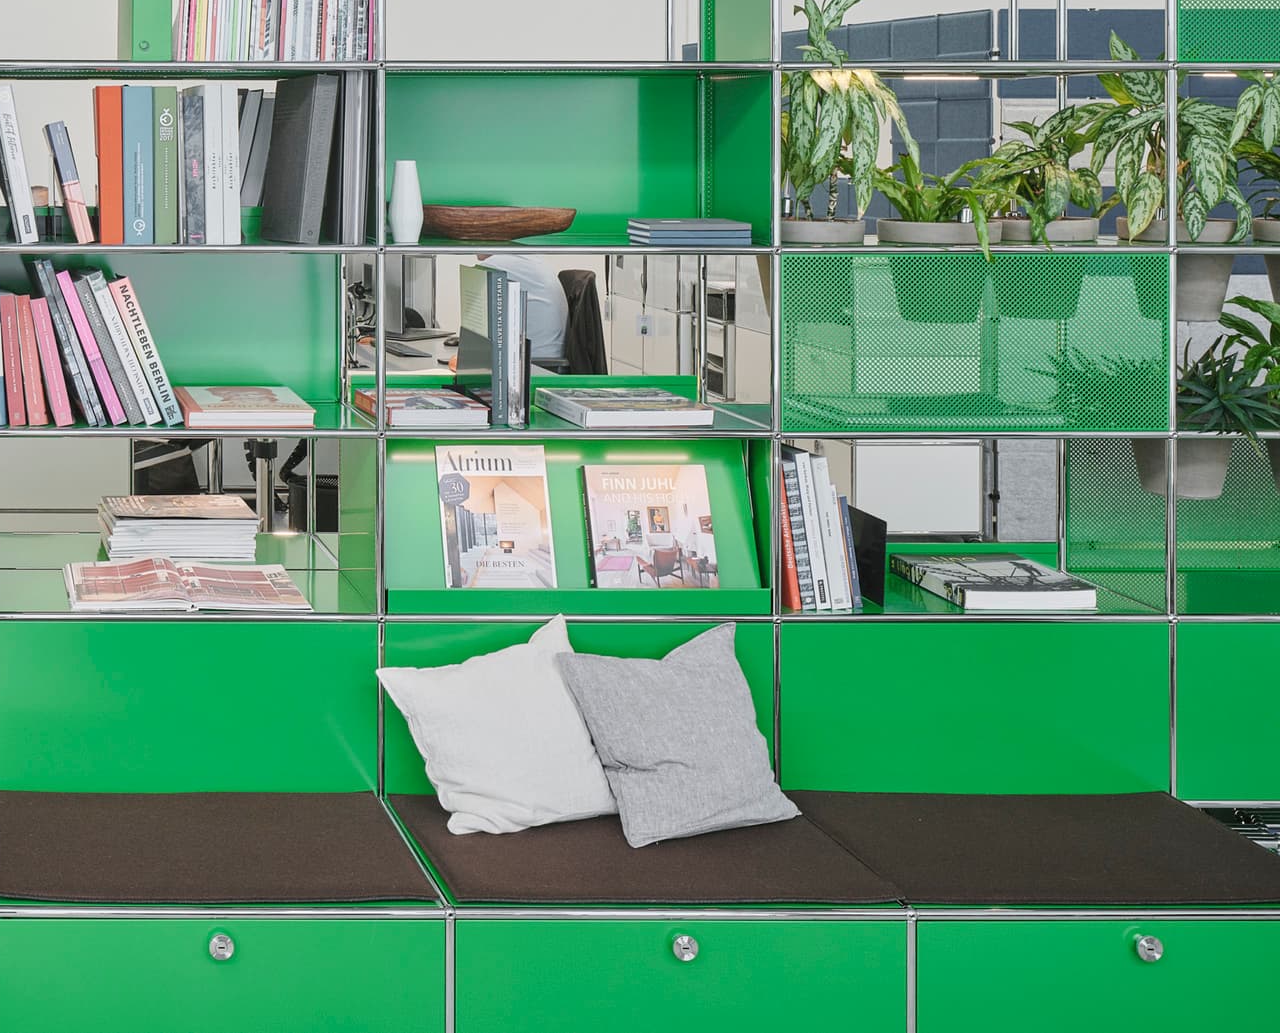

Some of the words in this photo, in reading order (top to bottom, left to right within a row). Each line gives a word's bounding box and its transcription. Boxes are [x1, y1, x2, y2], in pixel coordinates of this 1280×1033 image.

[119, 284, 154, 359] NACHTLEBEN
[148, 358, 171, 404] BERLIN
[442, 450, 513, 472] Atrium
[450, 481, 464, 494] 30
[601, 477, 636, 490] FINN
[640, 477, 677, 490] JUHL
[475, 560, 491, 568] DIE
[492, 560, 525, 568] BESTEN
